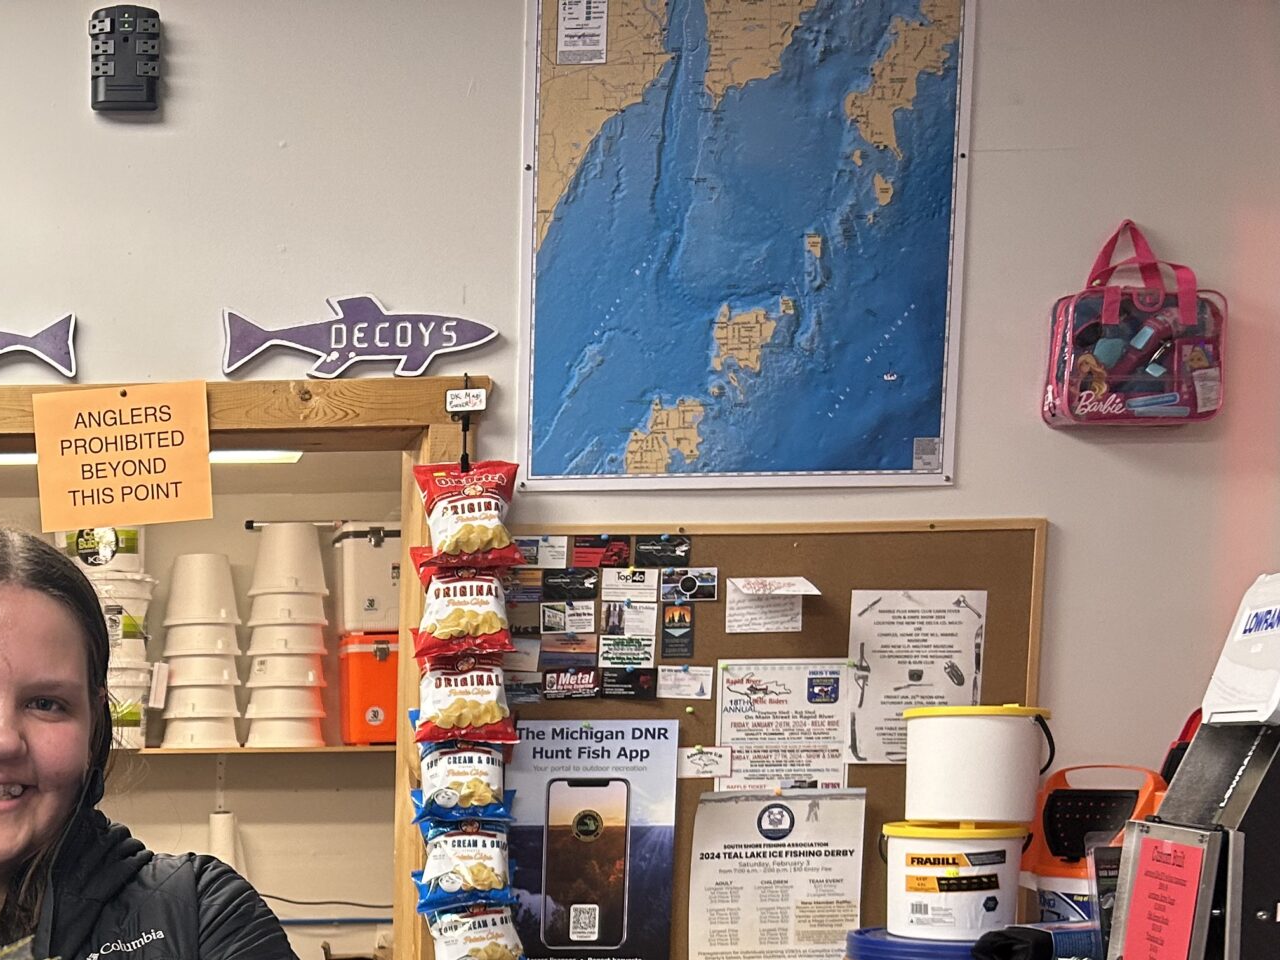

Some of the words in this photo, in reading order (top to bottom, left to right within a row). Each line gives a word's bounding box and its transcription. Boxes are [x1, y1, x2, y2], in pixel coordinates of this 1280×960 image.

[330, 320, 457, 349] DECOYS
[1076, 390, 1126, 414] Barbie
[74, 405, 172, 429] ANGLERS
[60, 430, 184, 456] PROHIBITED
[81, 457, 167, 480] BEYOND
[68, 487, 114, 506] THIS
[121, 481, 182, 502] POINT
[616, 571, 632, 582] Top
[435, 674, 502, 689] ORIGINAL
[559, 671, 595, 685] Metal
[518, 728, 545, 740] The
[551, 727, 624, 743] Michigan
[632, 728, 669, 740] DNR
[447, 755, 475, 764] CREAM
[533, 747, 572, 759] Hunt
[578, 747, 610, 759] Fish
[617, 747, 650, 761] App
[452, 840, 478, 848] CREAM
[699, 851, 720, 860] 2024
[745, 851, 767, 859] LAKE
[769, 850, 784, 858] ICE
[785, 850, 823, 858] FISHING
[824, 849, 855, 857] DERBY
[911, 857, 959, 865] FRABILL
[100, 929, 165, 954] Columbia
